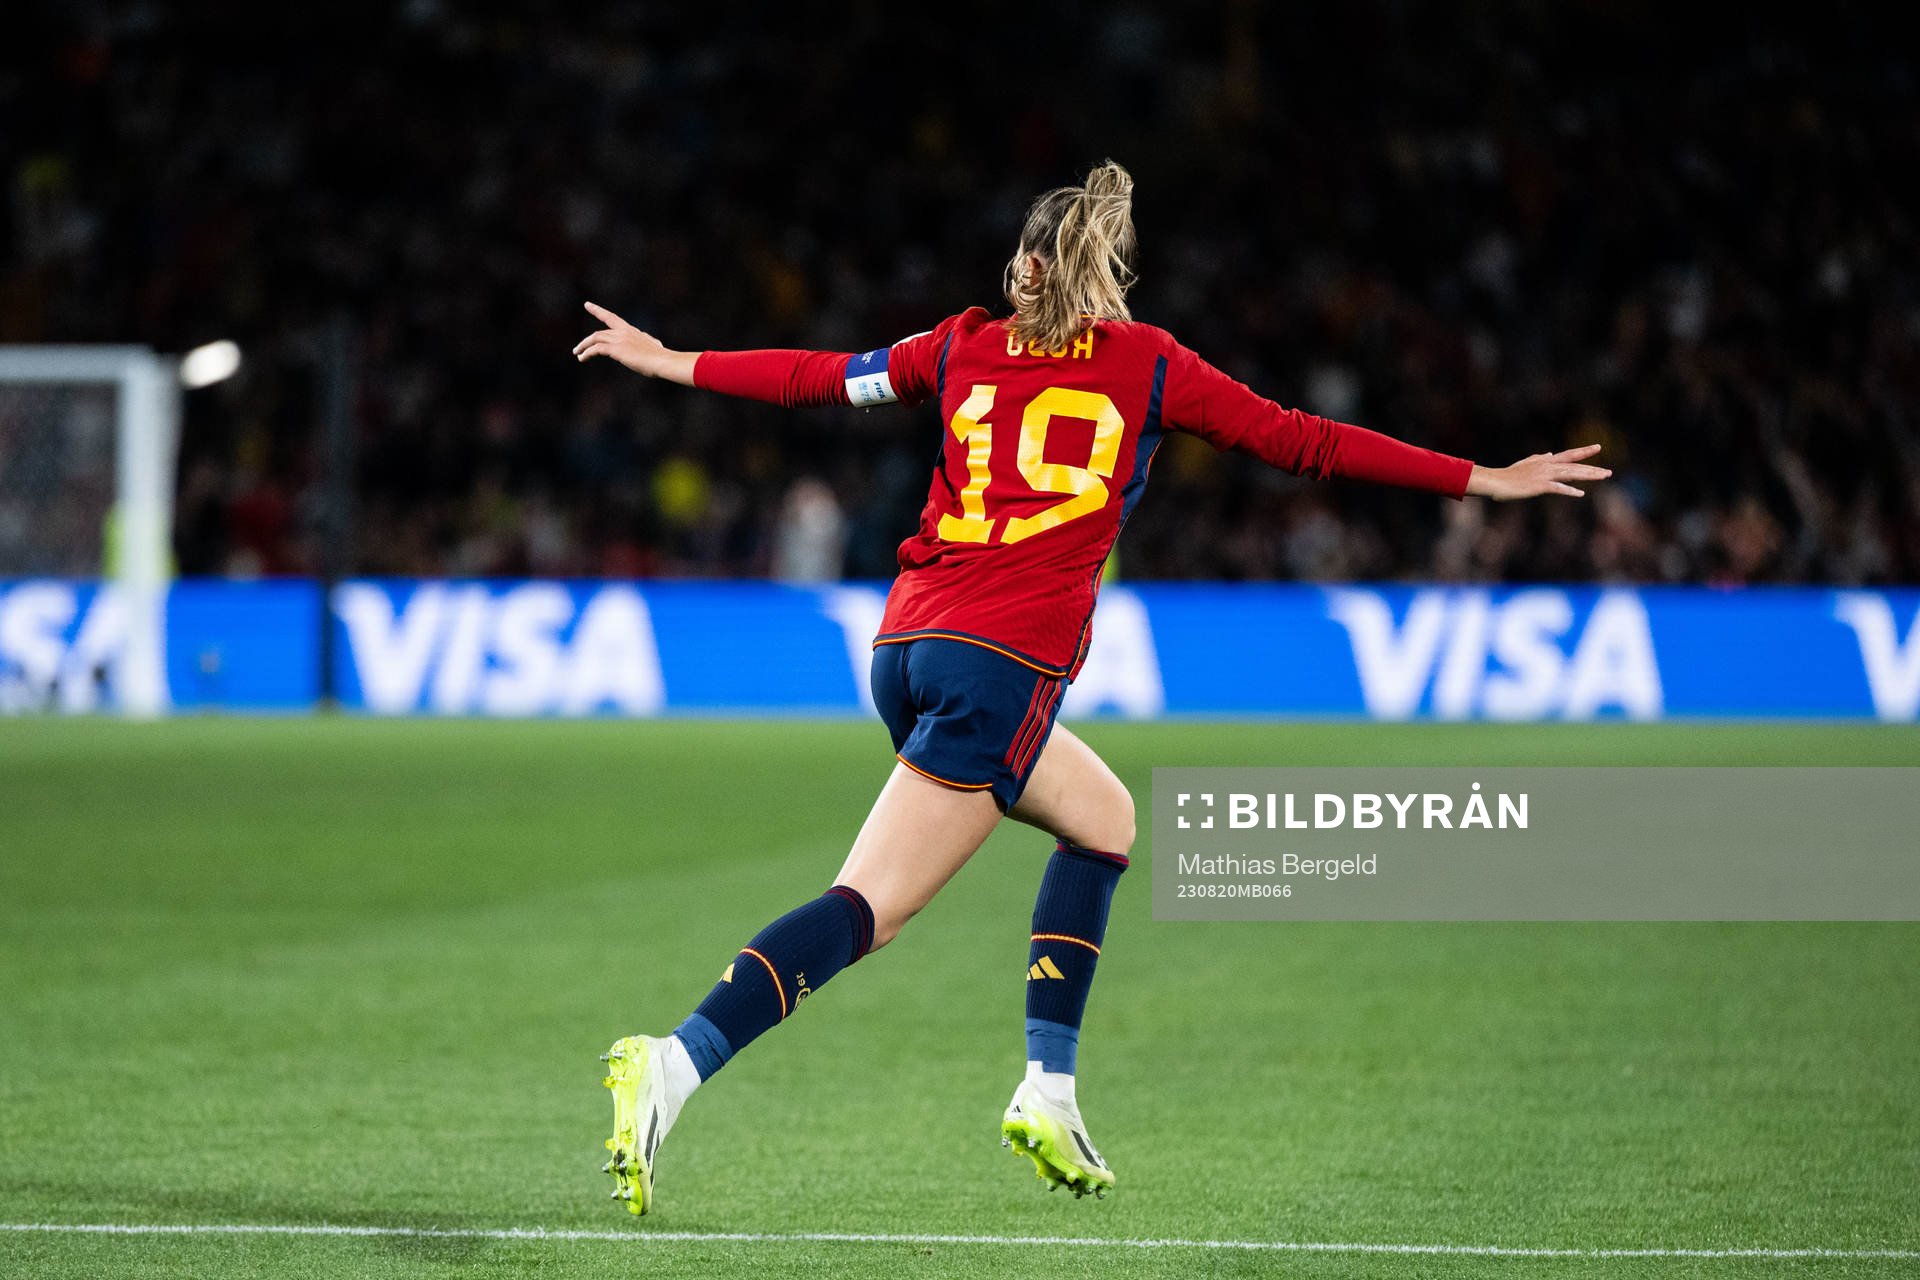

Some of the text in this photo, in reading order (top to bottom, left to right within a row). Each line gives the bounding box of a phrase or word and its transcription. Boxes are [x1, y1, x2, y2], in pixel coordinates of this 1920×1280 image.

[874, 382, 887, 399] FIFA
[937, 384, 1124, 544] 19
[332, 582, 667, 717] VISA
[825, 586, 1165, 720] VA
[1326, 588, 1664, 721] VISA
